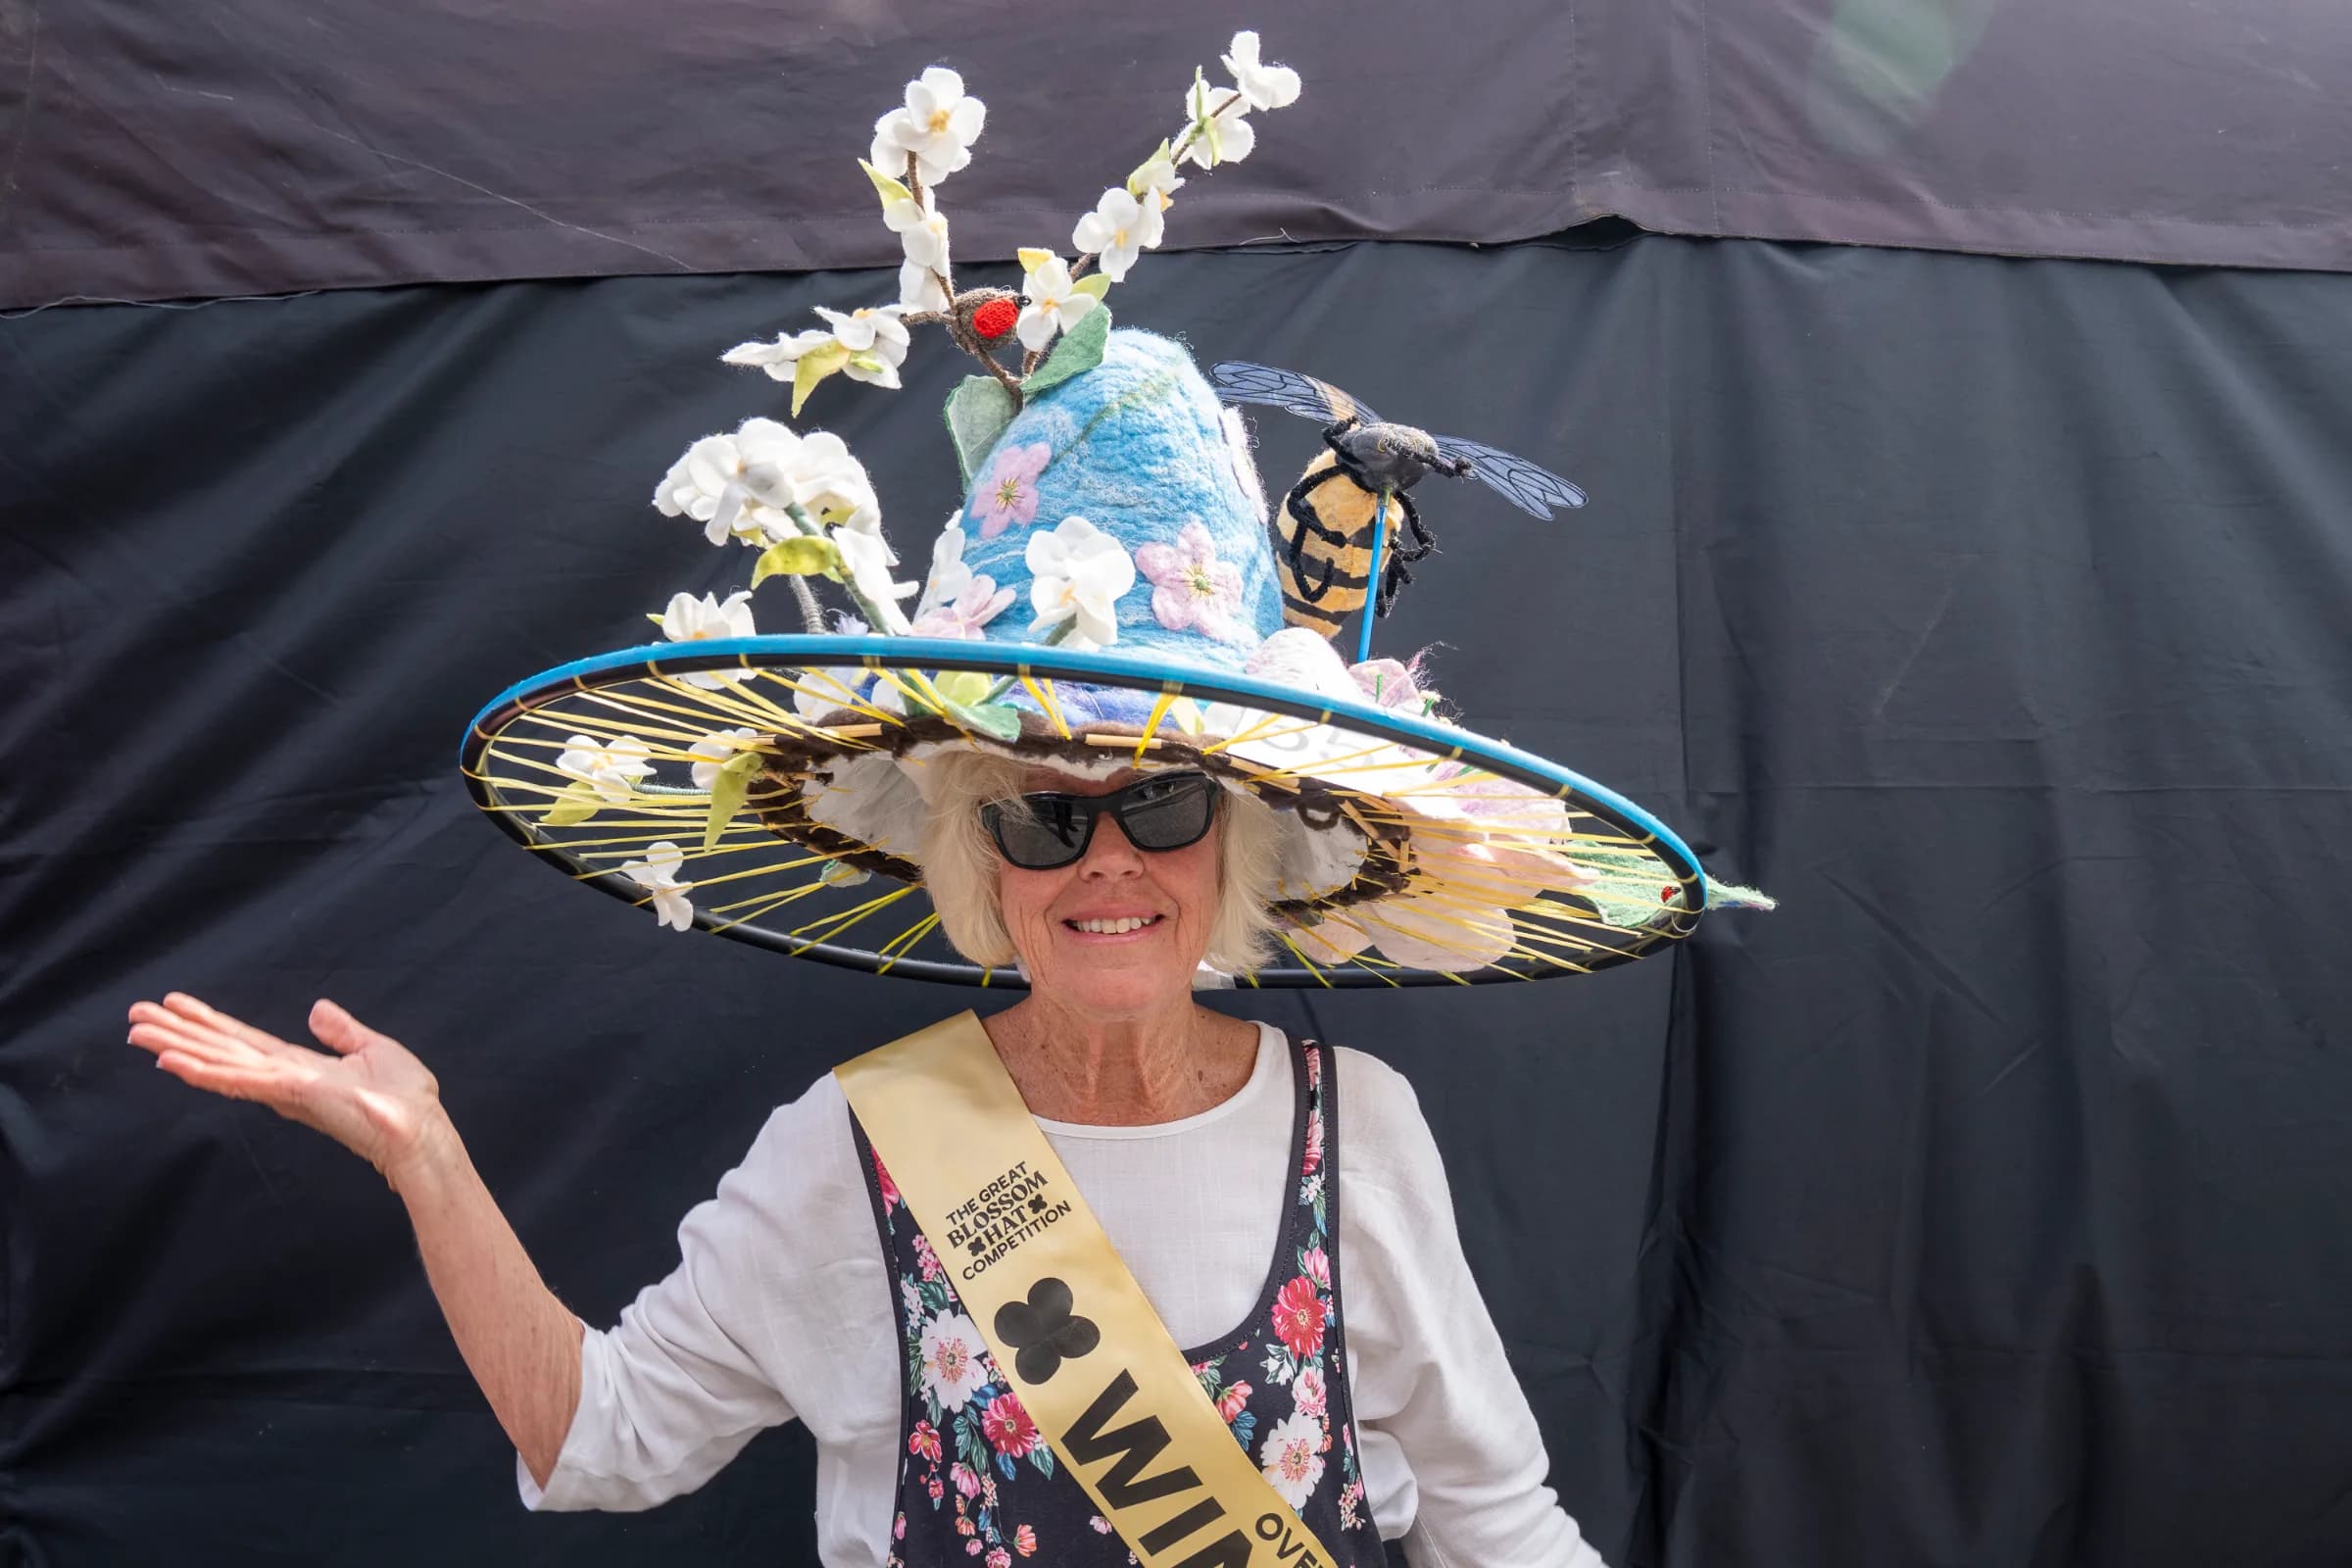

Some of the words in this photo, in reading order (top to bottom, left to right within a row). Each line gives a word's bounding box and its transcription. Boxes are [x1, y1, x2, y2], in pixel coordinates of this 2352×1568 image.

[946, 1199, 979, 1225] THE
[979, 1161, 1027, 1202] GREAT
[947, 1171, 1049, 1249] BLOSSOM
[982, 1206, 1029, 1246] HAT
[962, 1200, 1071, 1280] COMPETITION
